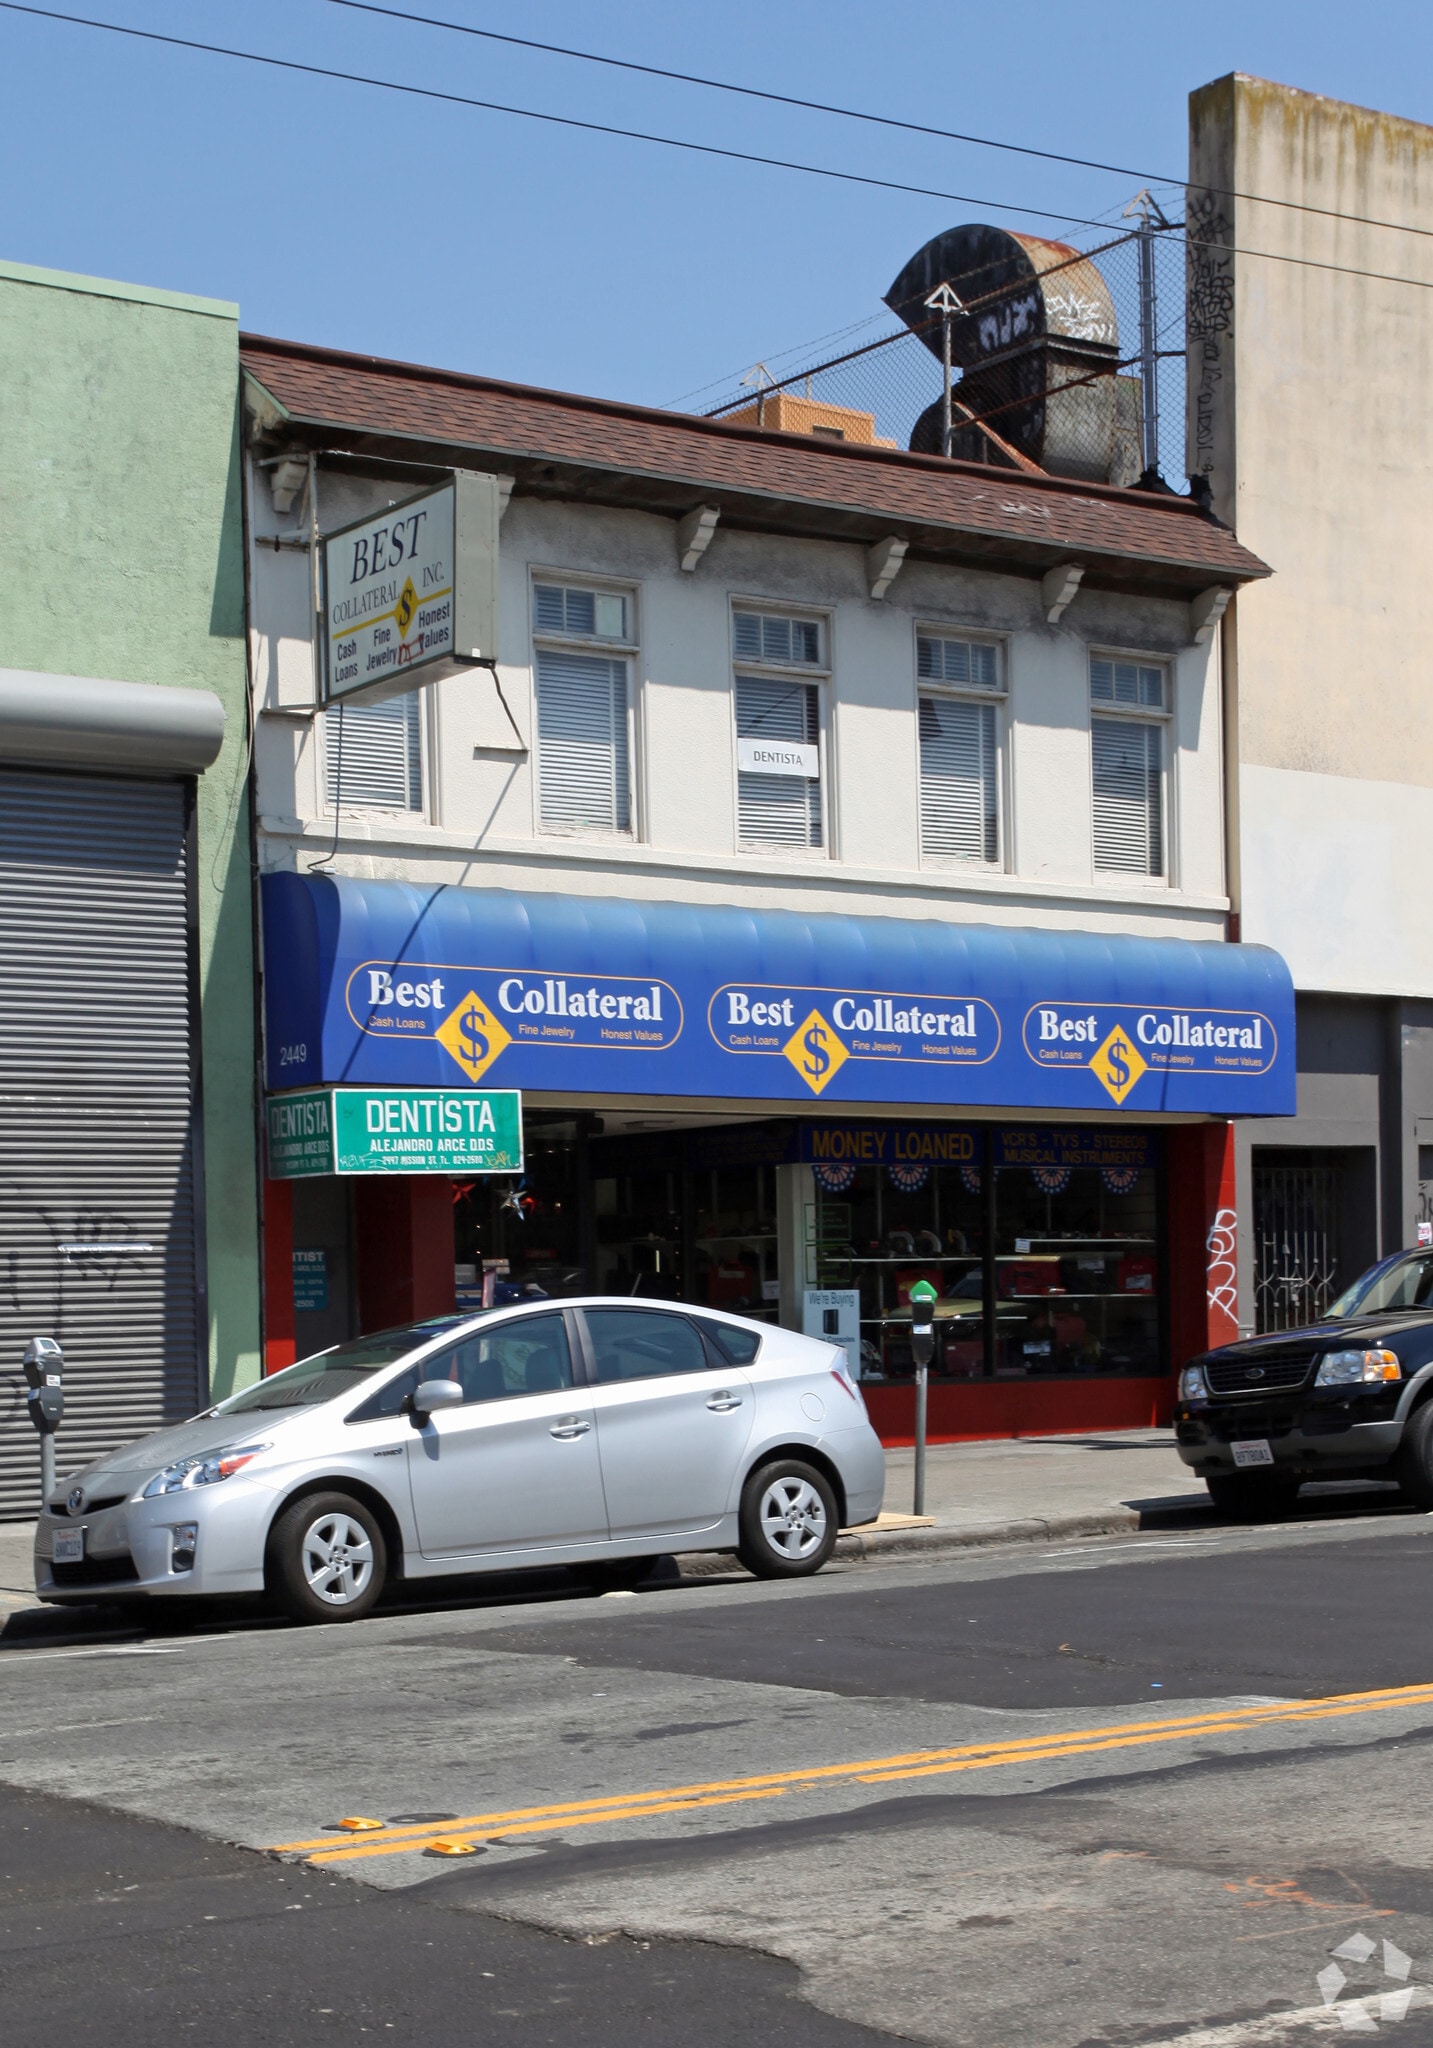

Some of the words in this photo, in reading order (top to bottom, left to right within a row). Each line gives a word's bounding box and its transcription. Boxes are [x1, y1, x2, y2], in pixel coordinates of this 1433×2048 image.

[350, 511, 427, 584] BEST
[332, 580, 400, 625] COLLATERAL
[418, 601, 451, 629] Honest
[373, 628, 391, 647] Fine
[418, 626, 449, 649] Values
[337, 640, 357, 661] Cash
[366, 646, 398, 671] Jewelry
[335, 663, 358, 683] Loans
[753, 750, 803, 766] DENTISTA
[368, 970, 445, 1010] Best
[498, 978, 663, 1021] Collateral
[368, 1015, 393, 1028] Cash
[396, 1017, 426, 1029] Loans
[727, 992, 794, 1027] Best
[832, 998, 977, 1037] Collateral
[518, 1023, 539, 1036] Fine
[541, 1025, 575, 1039] Jewelry
[601, 1028, 633, 1040] Honest
[634, 1029, 663, 1042] Values
[1038, 1010, 1098, 1042] Best
[1136, 1014, 1262, 1049] Collateral
[729, 1034, 752, 1046] Cash
[753, 1035, 779, 1047] Loans
[852, 1040, 871, 1051] Fine
[871, 1041, 902, 1055] Jewelry
[280, 1043, 307, 1066] 2449
[922, 1044, 950, 1055] Honest
[950, 1045, 977, 1056] Values
[1039, 1048, 1059, 1059] Cash
[1060, 1049, 1082, 1060] Loans
[1151, 1052, 1167, 1063] Fine
[1168, 1053, 1195, 1066] Jewelry
[1214, 1055, 1239, 1066] Honest
[1240, 1057, 1262, 1067] Values
[369, 1138, 433, 1152] ALEJANDRO
[812, 1130, 887, 1159] MONEY
[895, 1132, 974, 1160] LOANED
[1001, 1132, 1037, 1147] VCR'S
[1053, 1134, 1079, 1148] TV'S
[1094, 1135, 1148, 1149] STEREOS
[401, 1155, 426, 1165] MISSION
[1004, 1150, 1058, 1164] MUSICAL
[1062, 1150, 1146, 1165] INSTRUMENTS
[809, 1292, 829, 1305] We're
[831, 1292, 854, 1307] Buying
